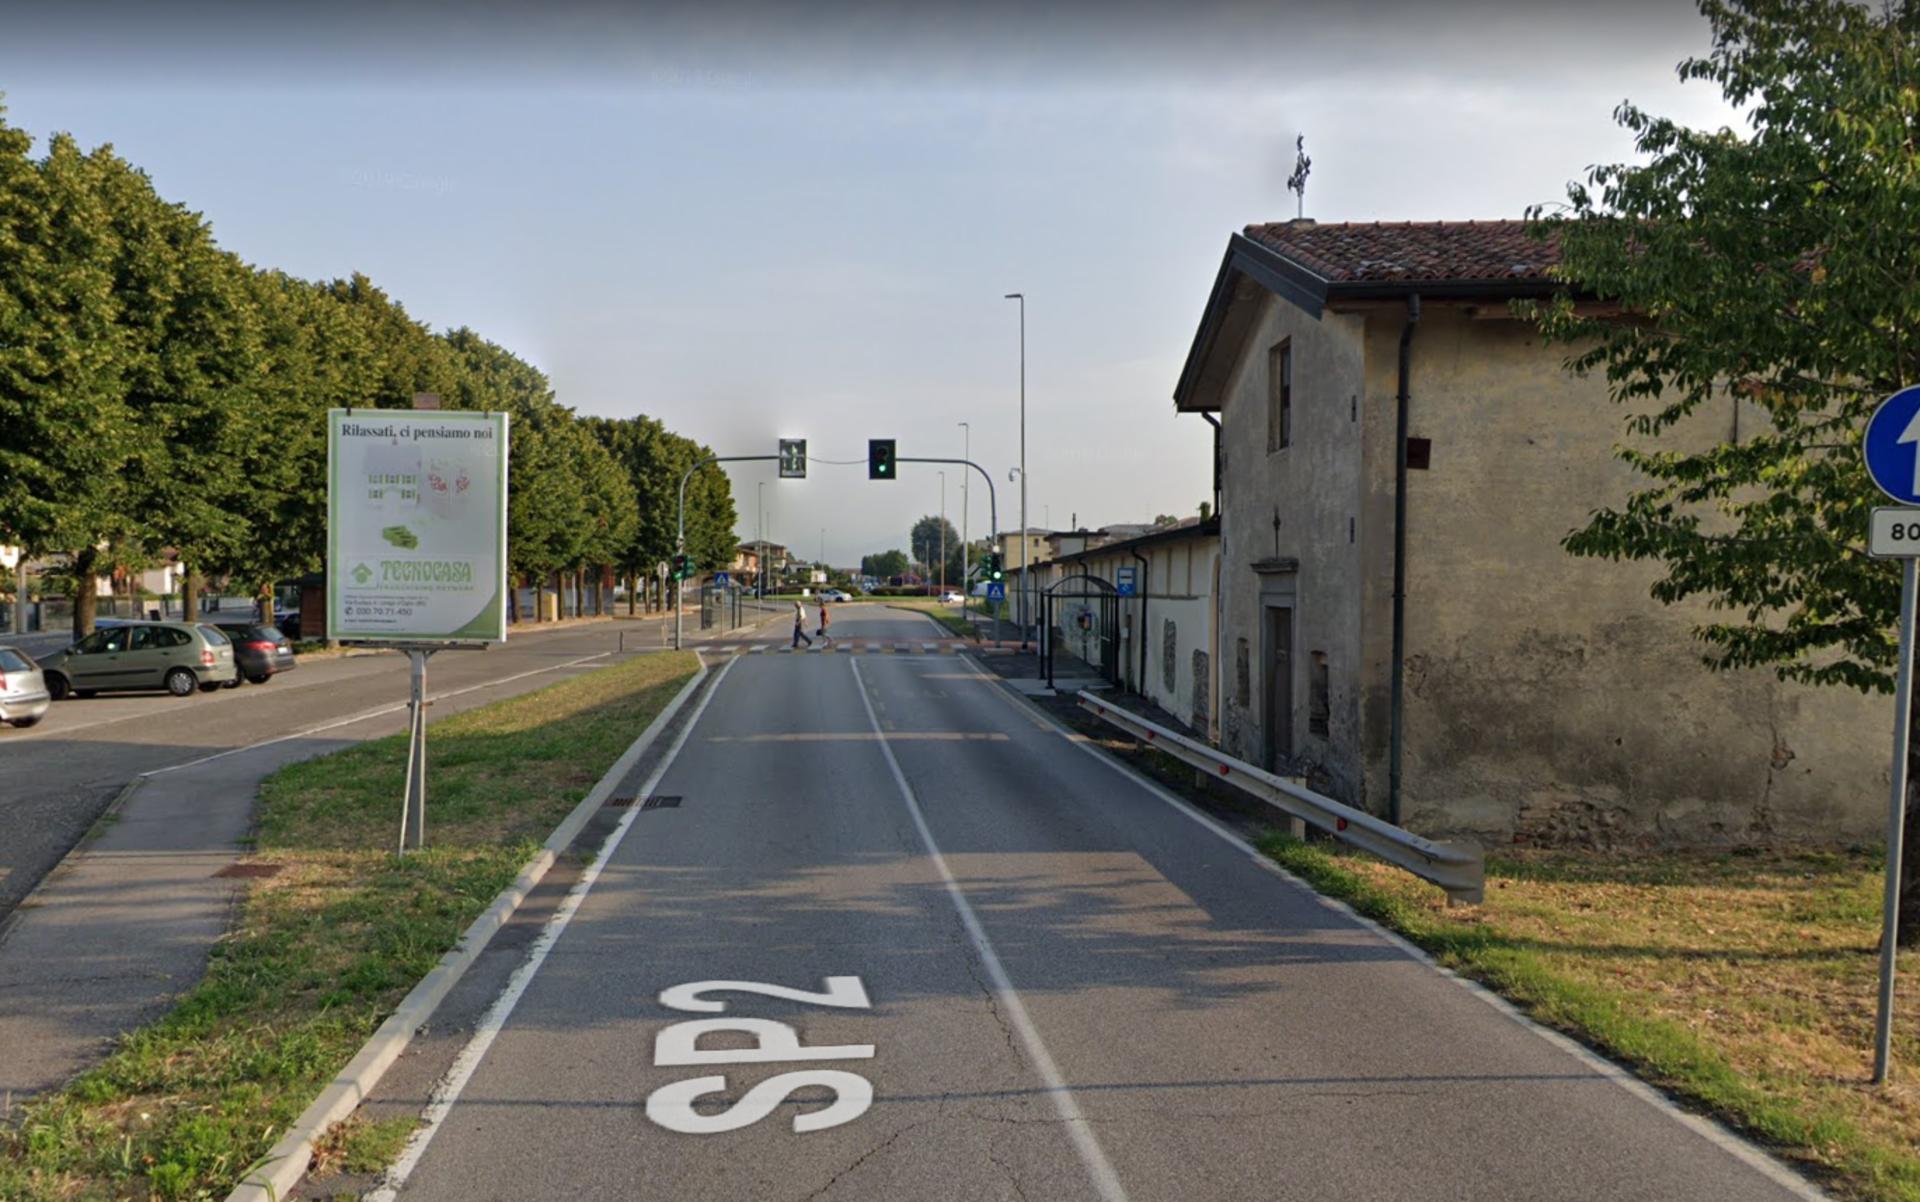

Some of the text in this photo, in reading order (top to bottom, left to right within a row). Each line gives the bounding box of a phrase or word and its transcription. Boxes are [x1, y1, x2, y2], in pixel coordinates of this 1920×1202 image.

[341, 423, 493, 441] Rilassati, ci pensiamo noi
[380, 561, 471, 582] TECNOCASA
[646, 975, 875, 1134] SP2
